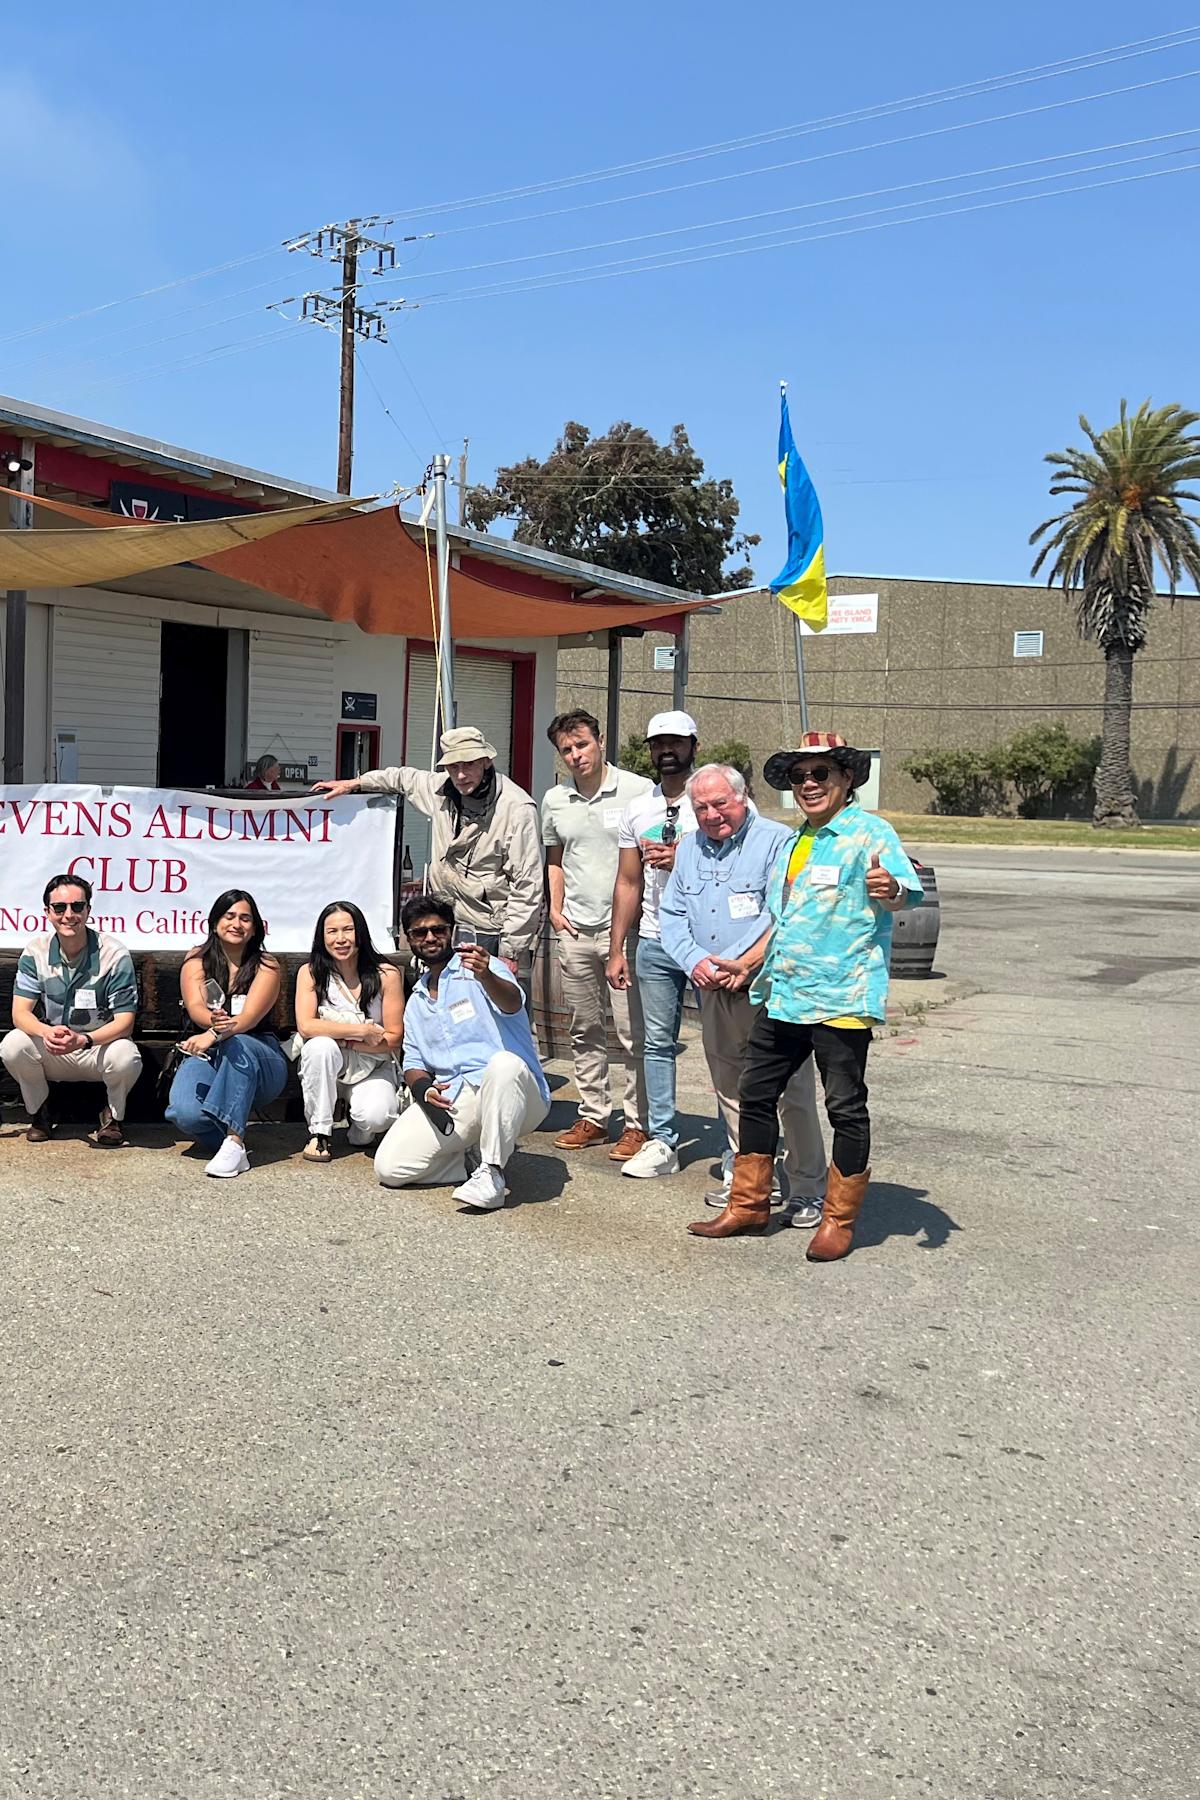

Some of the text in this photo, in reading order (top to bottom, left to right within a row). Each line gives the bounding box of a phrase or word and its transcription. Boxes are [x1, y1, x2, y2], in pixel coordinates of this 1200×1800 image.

[845, 608, 872, 617] ISLAND
[851, 616, 873, 624] YMCA
[284, 767, 305, 779] OPEN
[143, 804, 334, 842] ALUMNI
